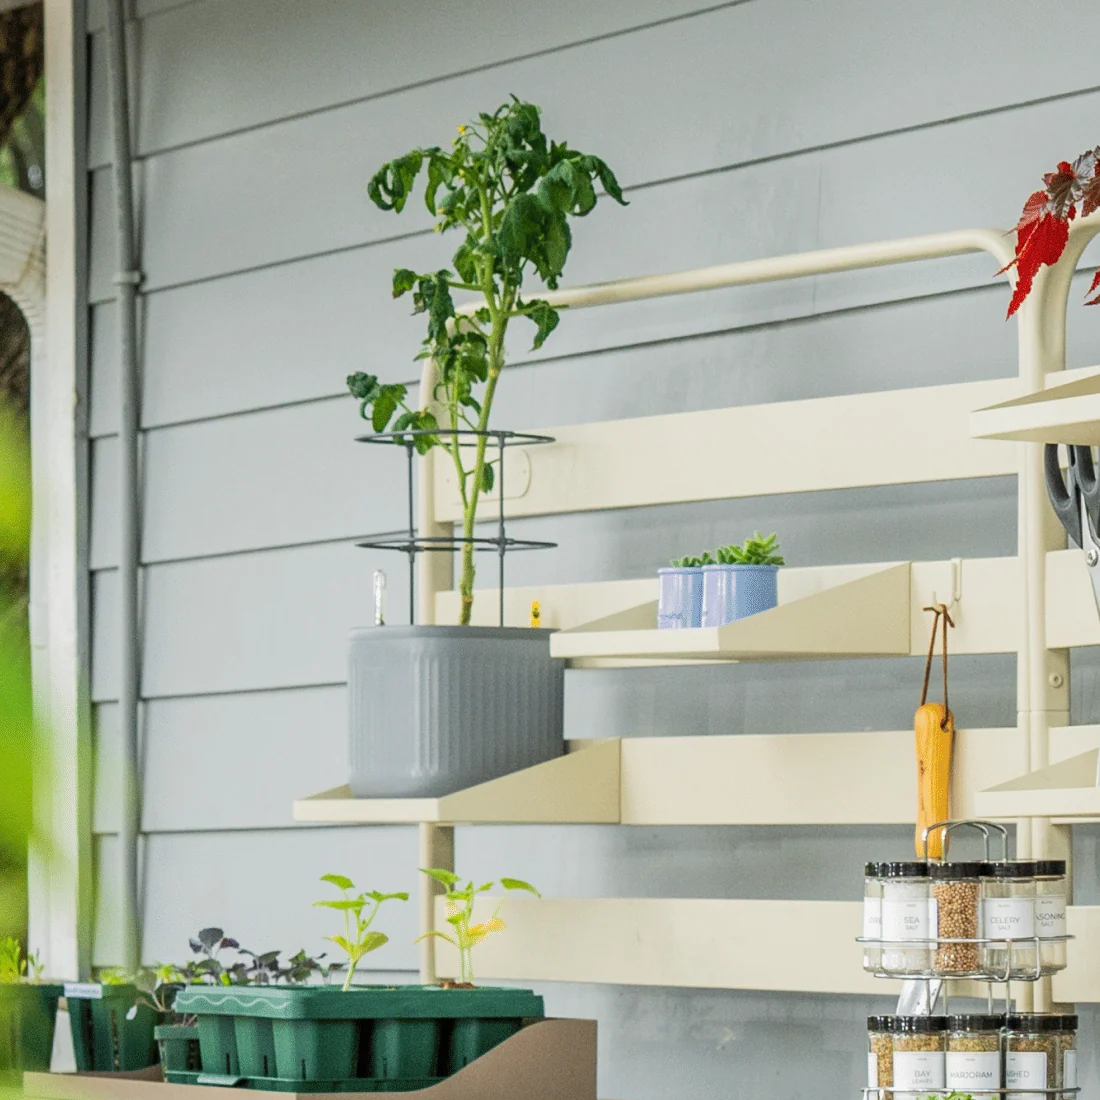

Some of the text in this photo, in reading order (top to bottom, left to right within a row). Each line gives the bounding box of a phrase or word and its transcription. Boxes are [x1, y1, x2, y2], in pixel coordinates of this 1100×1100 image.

[903, 916, 920, 924] SEA
[990, 916, 1020, 924] CELERY
[914, 1070, 931, 1078] BAY
[950, 1071, 993, 1080] MARJORAM
